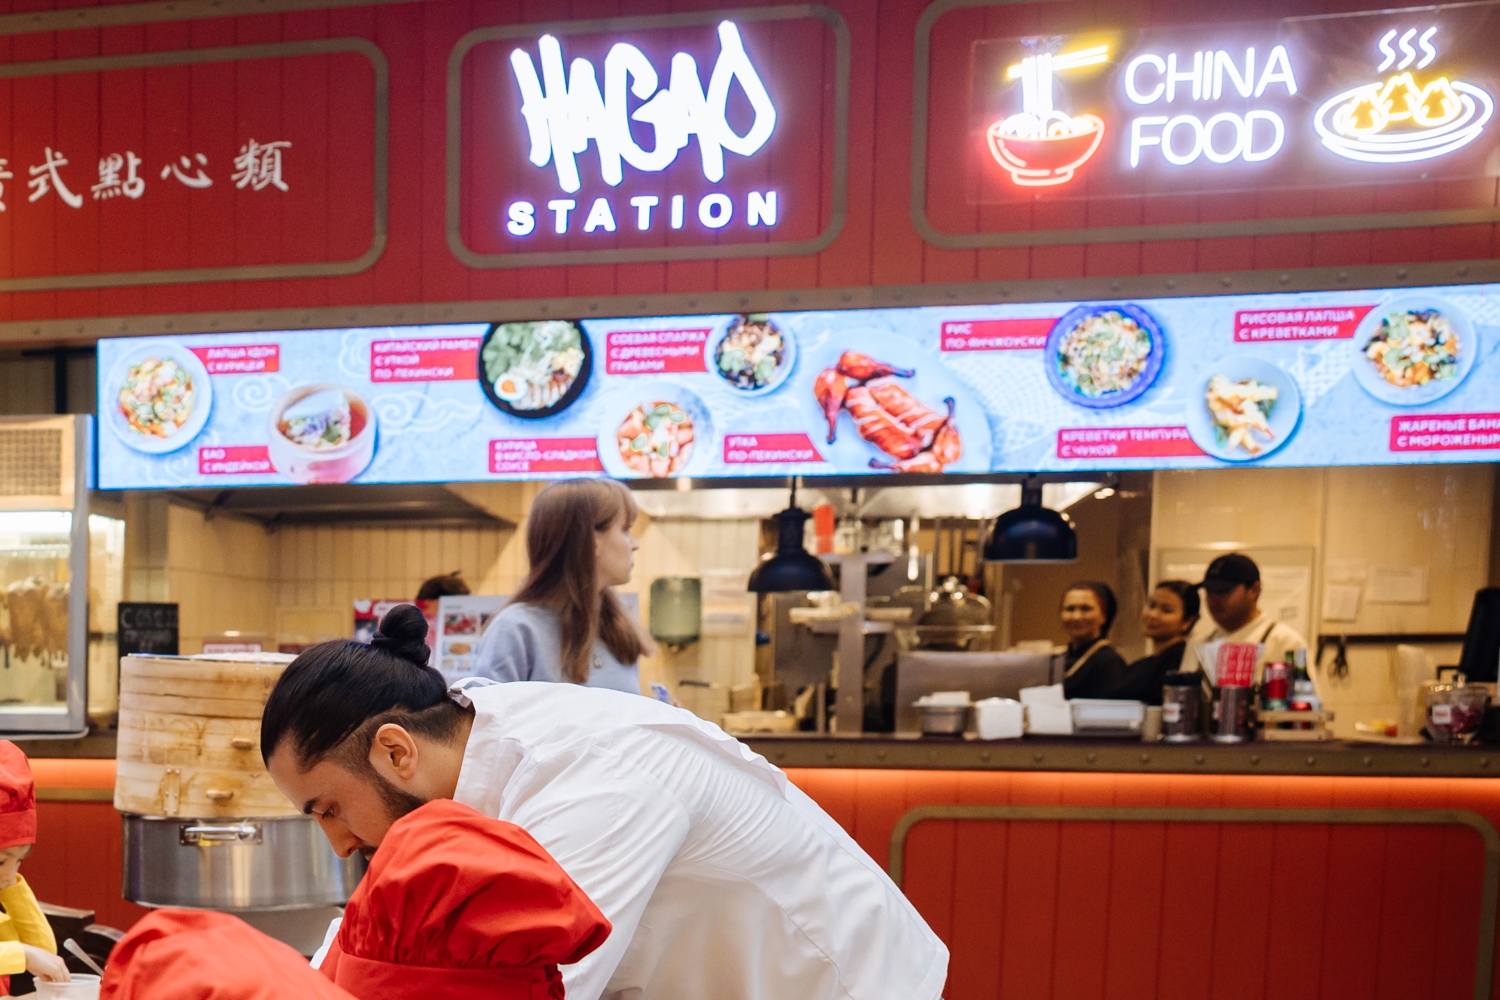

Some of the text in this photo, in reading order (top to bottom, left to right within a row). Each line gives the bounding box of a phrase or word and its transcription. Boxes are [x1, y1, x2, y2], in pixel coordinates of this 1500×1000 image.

[1124, 44, 1297, 105] CHINA
[1129, 109, 1285, 168] FOOD
[506, 190, 778, 236] STATION
[1240, 310, 1355, 325] РИСОВАЯ ЛАПША
[945, 323, 973, 335] РИС
[1251, 325, 1339, 339] КРЕВЕТКАМИ
[609, 331, 706, 346] СОЕВАЯ СПАРЖА
[1398, 419, 1466, 433] ЖАРЕНЫЕ
[1061, 429, 1190, 442] КРЕВЕТКИ ТЕМПУРА
